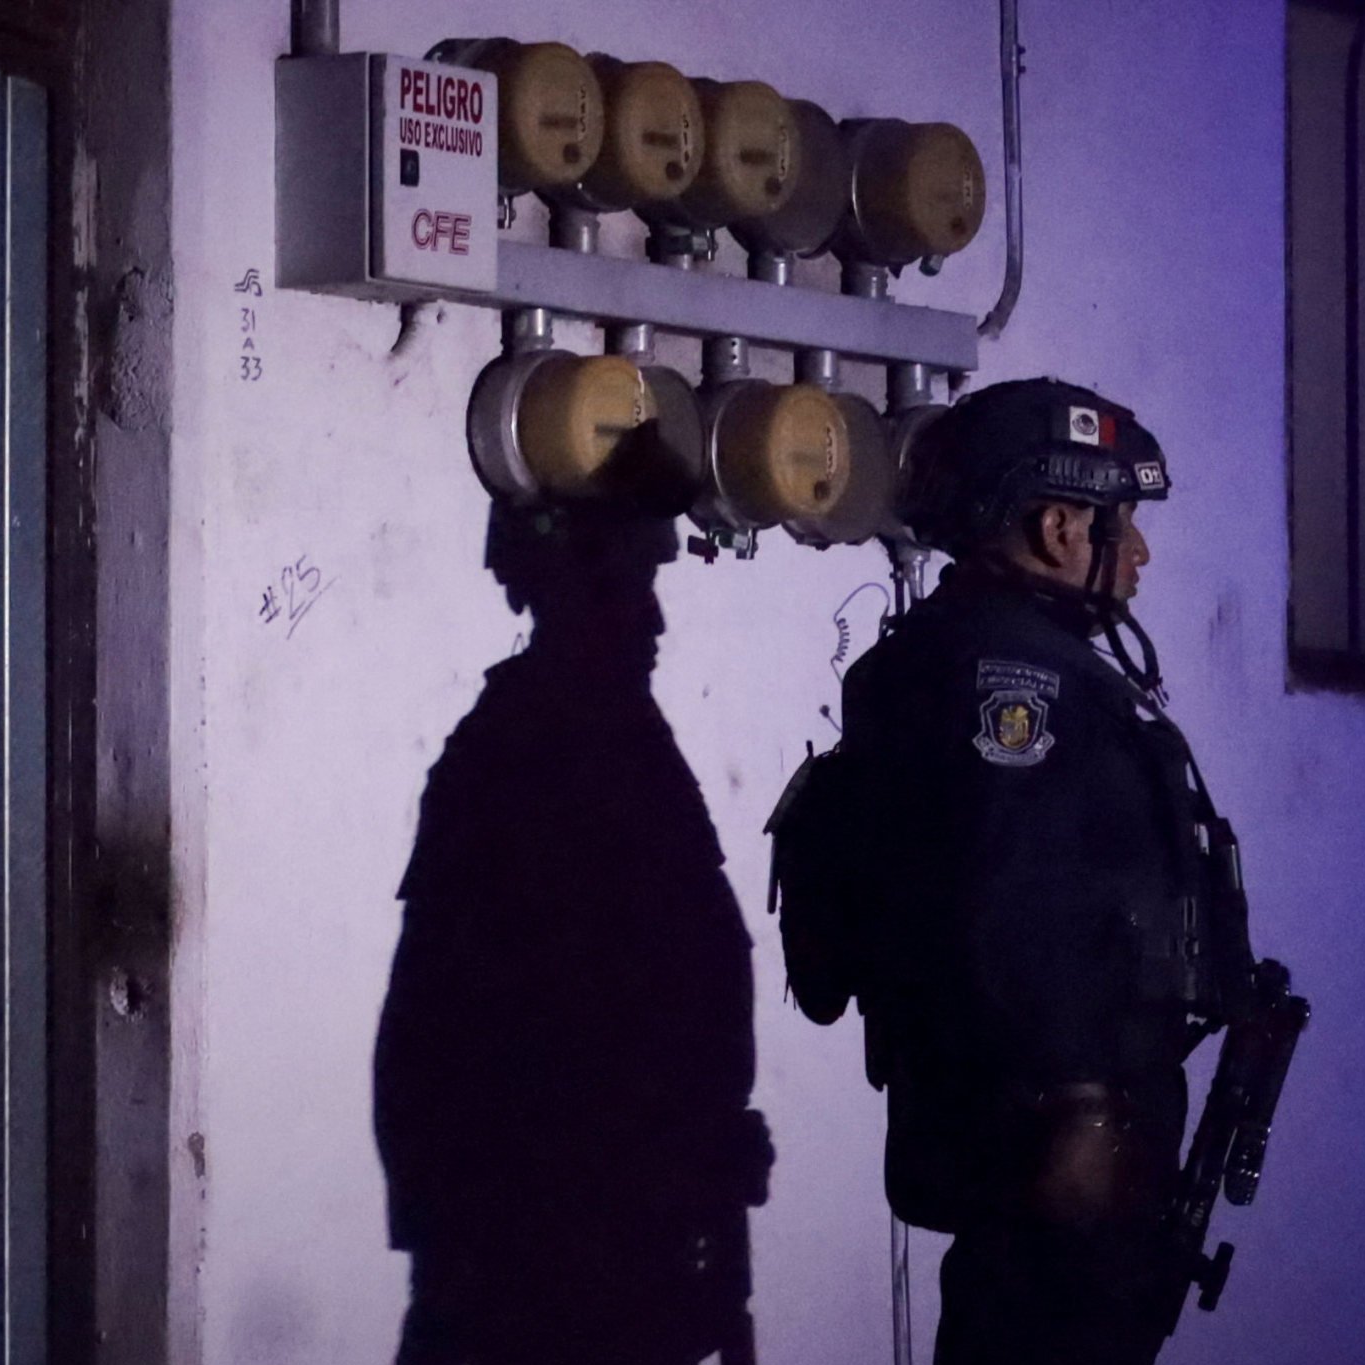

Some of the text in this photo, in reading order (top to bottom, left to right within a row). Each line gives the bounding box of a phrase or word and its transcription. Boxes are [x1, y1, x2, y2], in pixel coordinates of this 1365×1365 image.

[400, 68, 483, 124] PELIGRO
[399, 117, 483, 157] USO EXCLUSIVO
[412, 208, 472, 256] CFE
[240, 307, 256, 332] 31
[242, 337, 255, 351] A
[240, 355, 263, 382] 33
